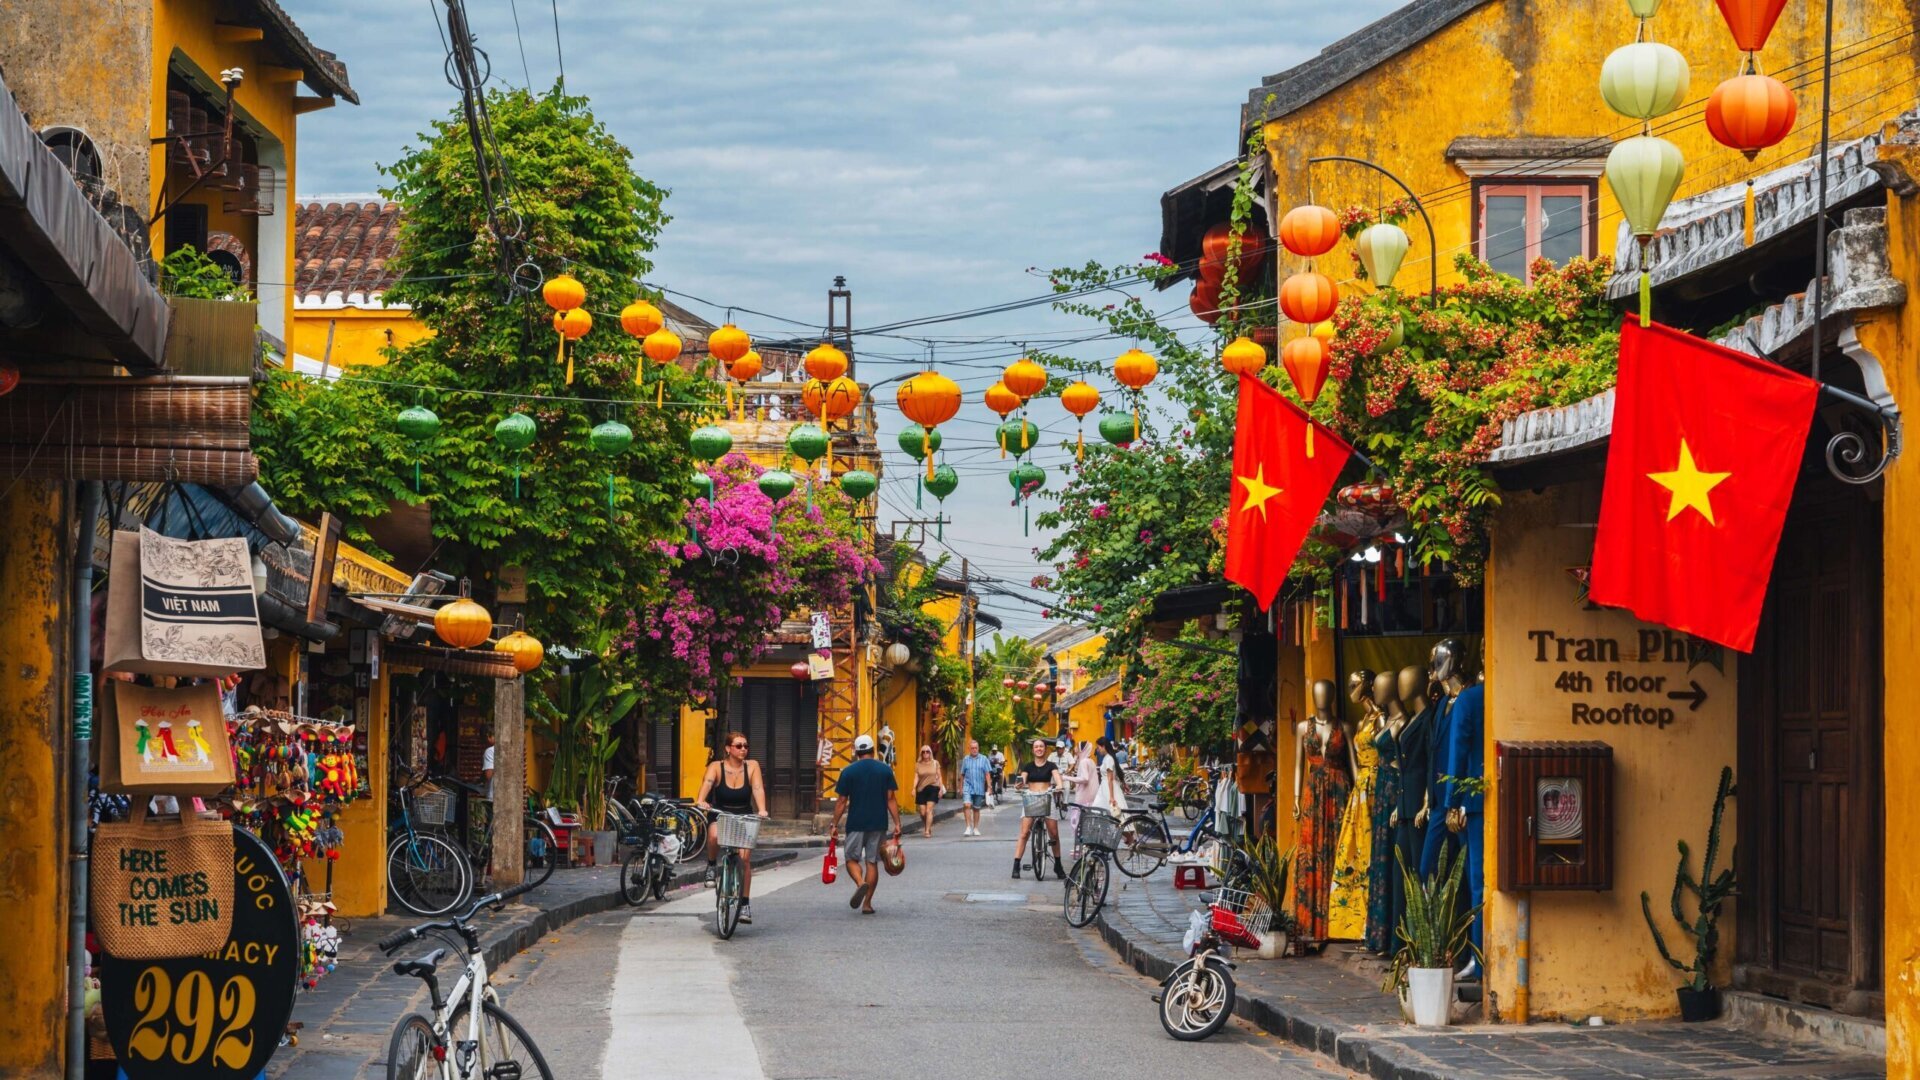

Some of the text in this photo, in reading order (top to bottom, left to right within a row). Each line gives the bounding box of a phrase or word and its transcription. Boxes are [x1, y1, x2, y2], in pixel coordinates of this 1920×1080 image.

[162, 596, 221, 613] VIỆT NAM
[1528, 629, 1620, 663] Tran
[1554, 670, 1666, 693] 4th floor
[1571, 702, 1675, 730] Rooftop
[119, 847, 168, 873] HERE
[130, 871, 209, 901] COMES
[118, 898, 219, 927] THE SUN
[128, 965, 257, 1070] 292
